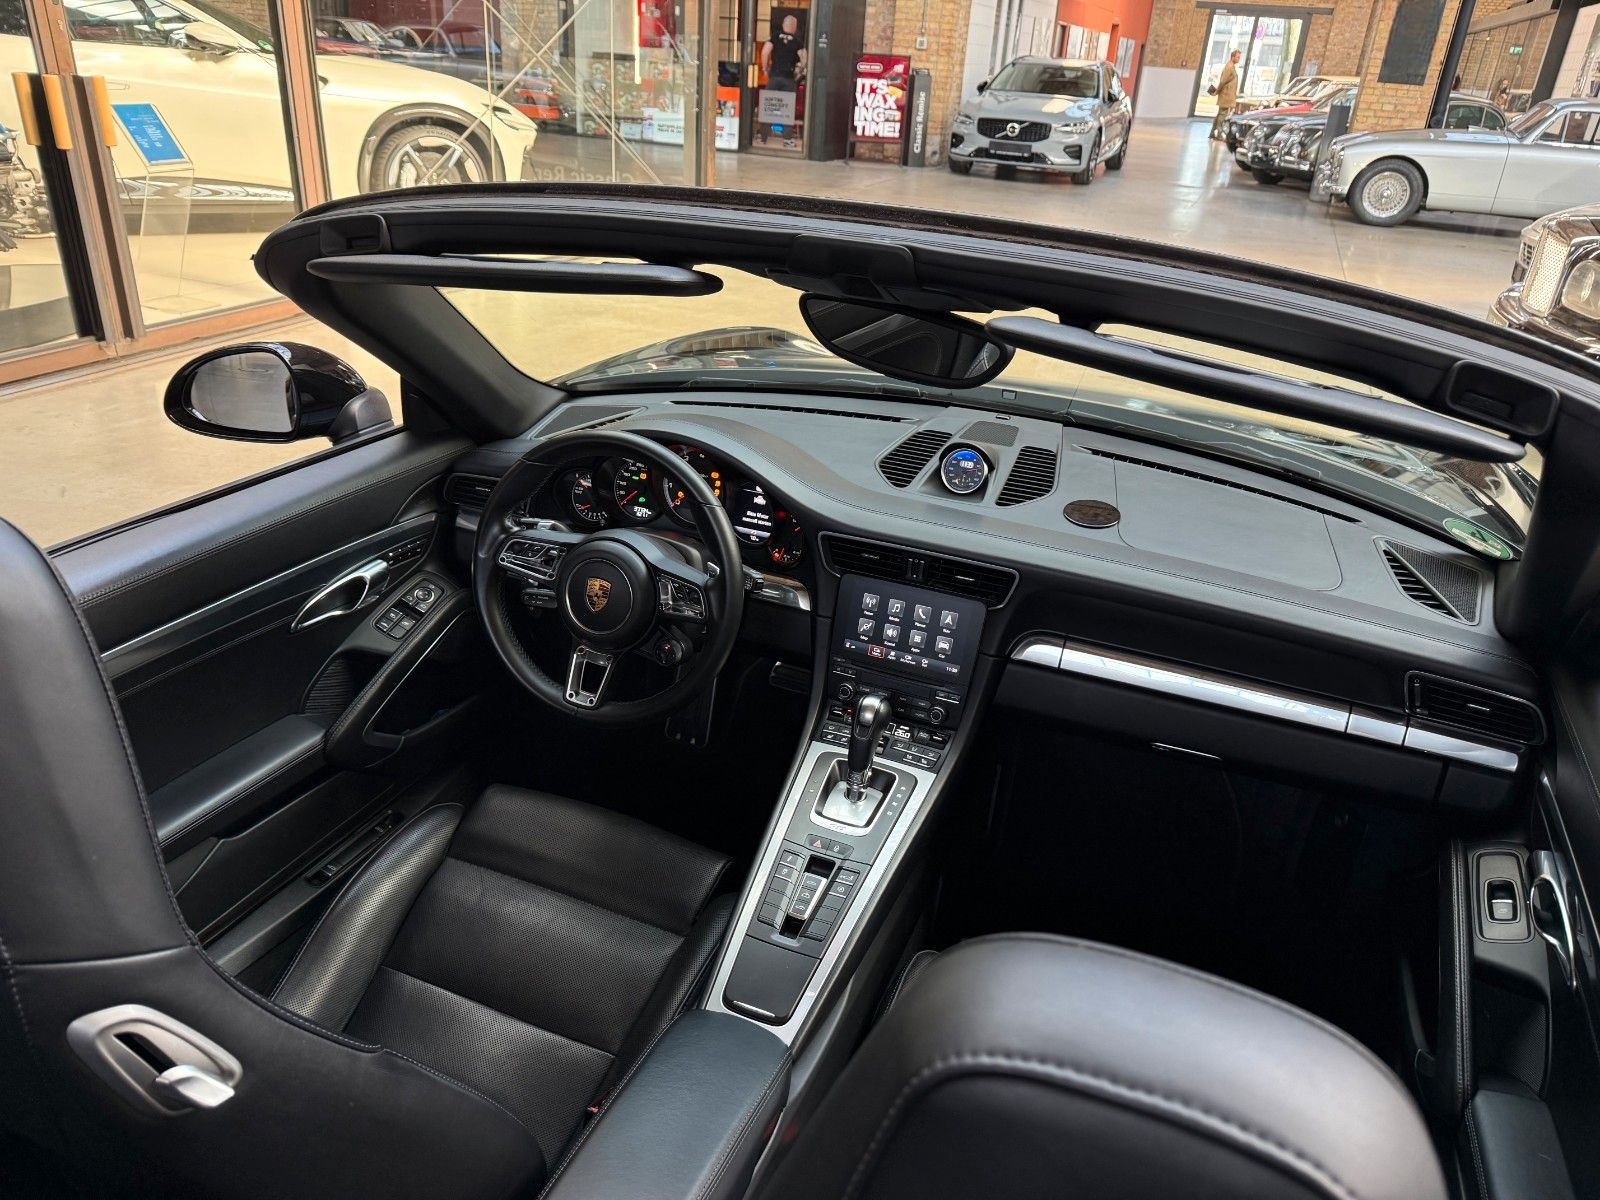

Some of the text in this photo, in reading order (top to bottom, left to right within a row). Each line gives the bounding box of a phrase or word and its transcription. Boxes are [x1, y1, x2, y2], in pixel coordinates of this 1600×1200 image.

[856, 78, 888, 94] IT'S
[856, 92, 897, 109] WAX
[854, 106, 886, 122] ING
[914, 91, 926, 154] Classic Remise
[854, 121, 900, 138] TIME!
